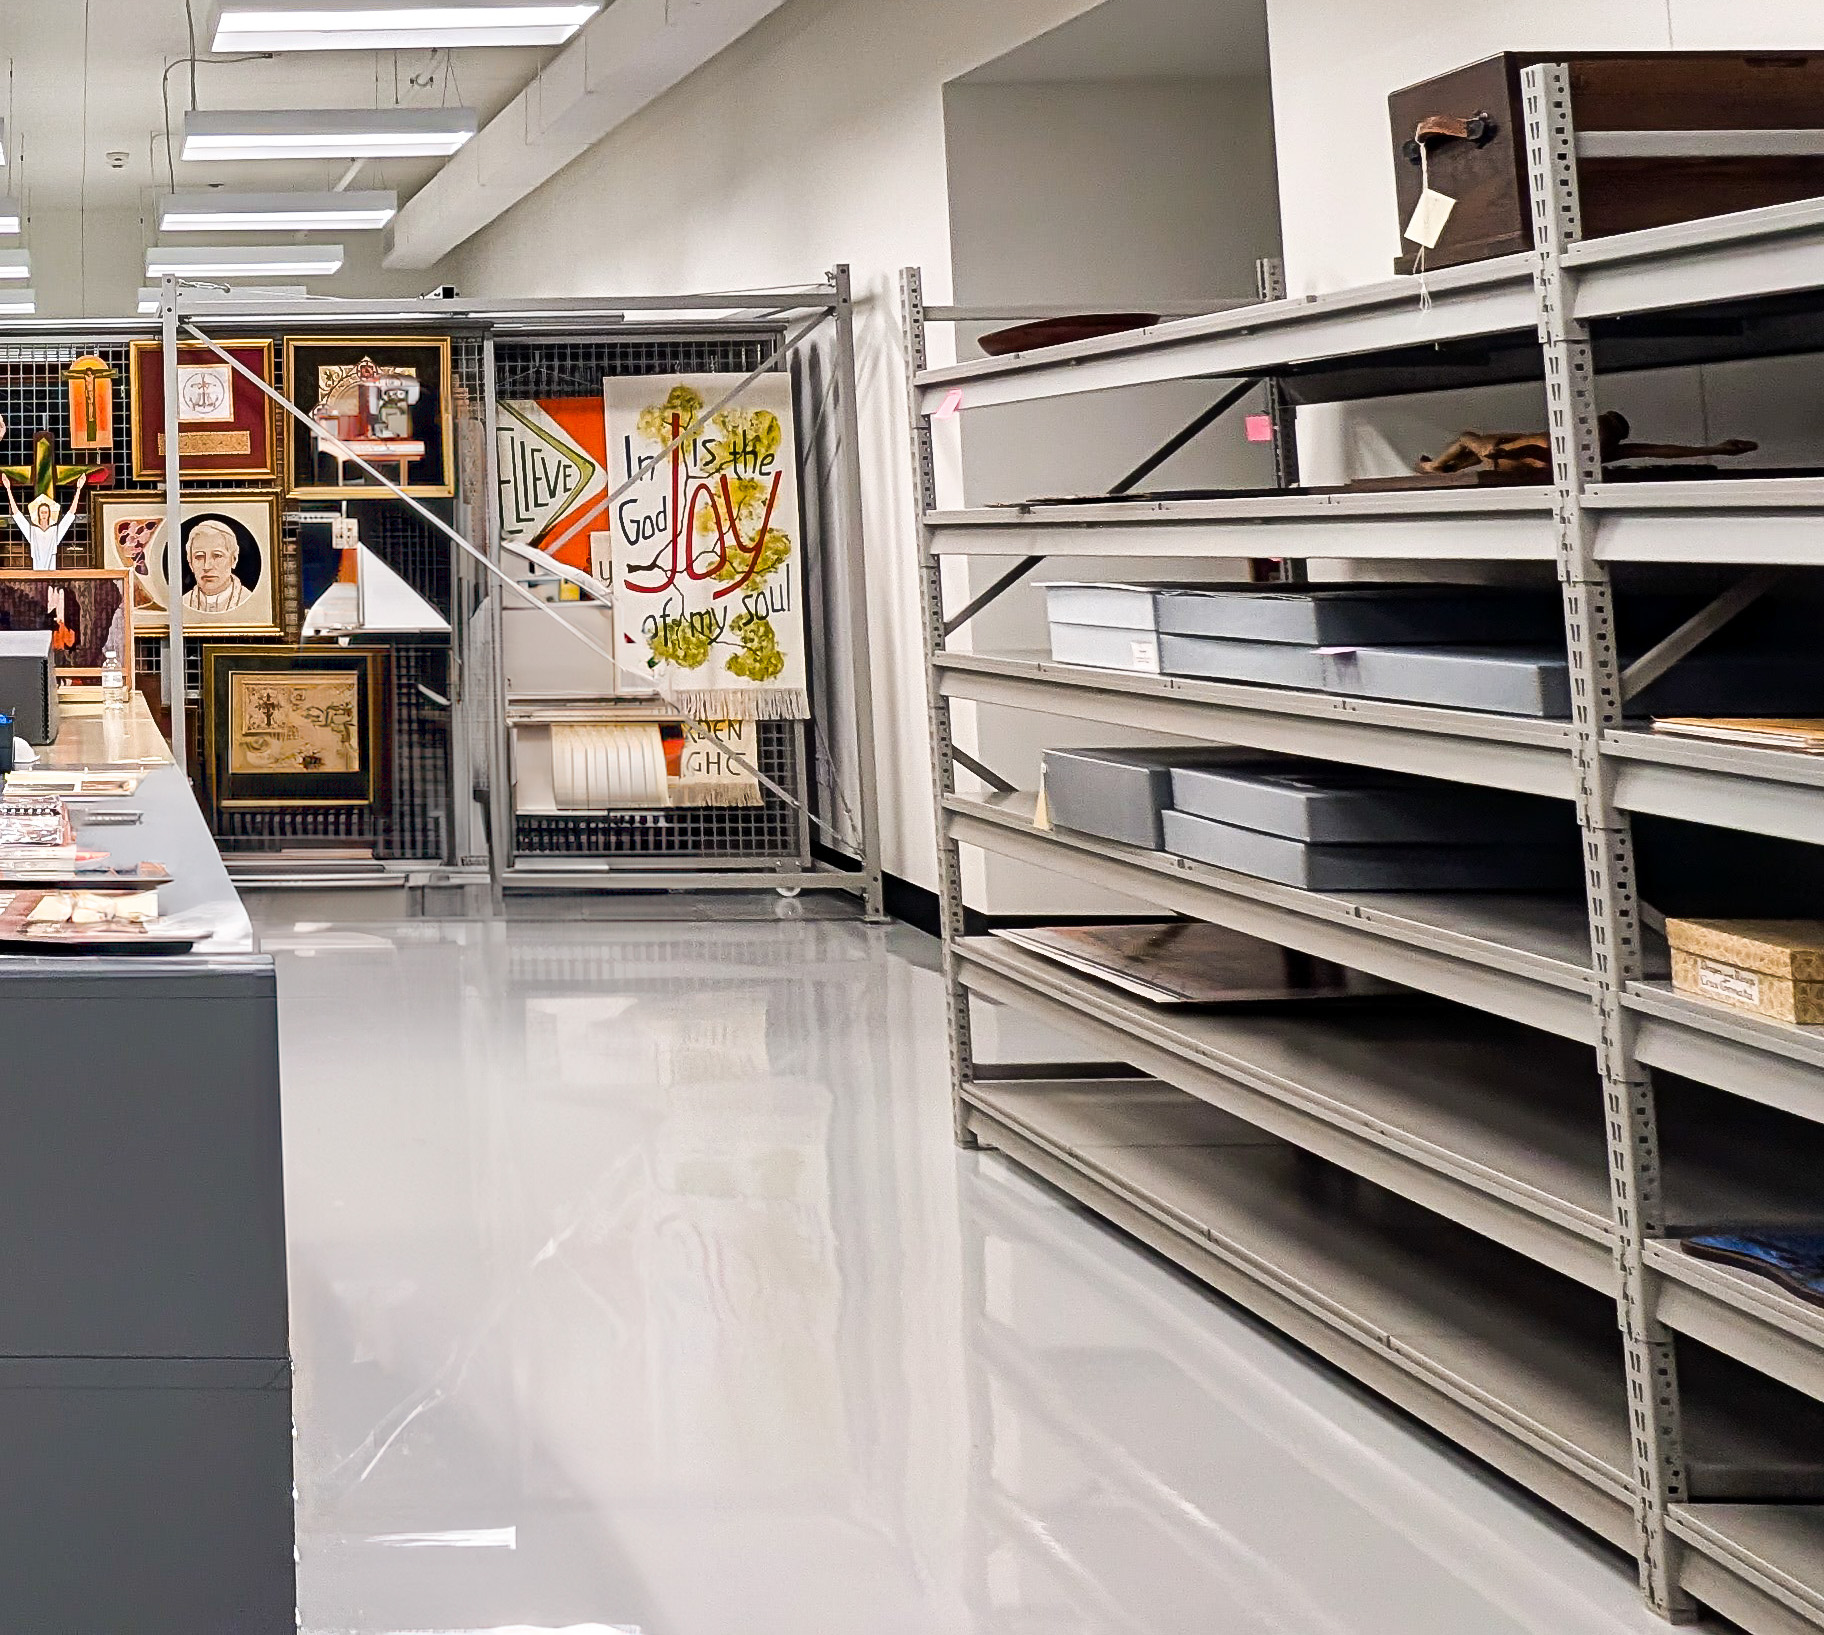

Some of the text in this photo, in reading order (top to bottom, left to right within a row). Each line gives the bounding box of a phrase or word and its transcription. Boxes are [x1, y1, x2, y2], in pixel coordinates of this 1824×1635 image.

[624, 429, 776, 482] In is the
[618, 495, 668, 547] God
[623, 412, 783, 601] Joy
[641, 563, 791, 648] of my soul
